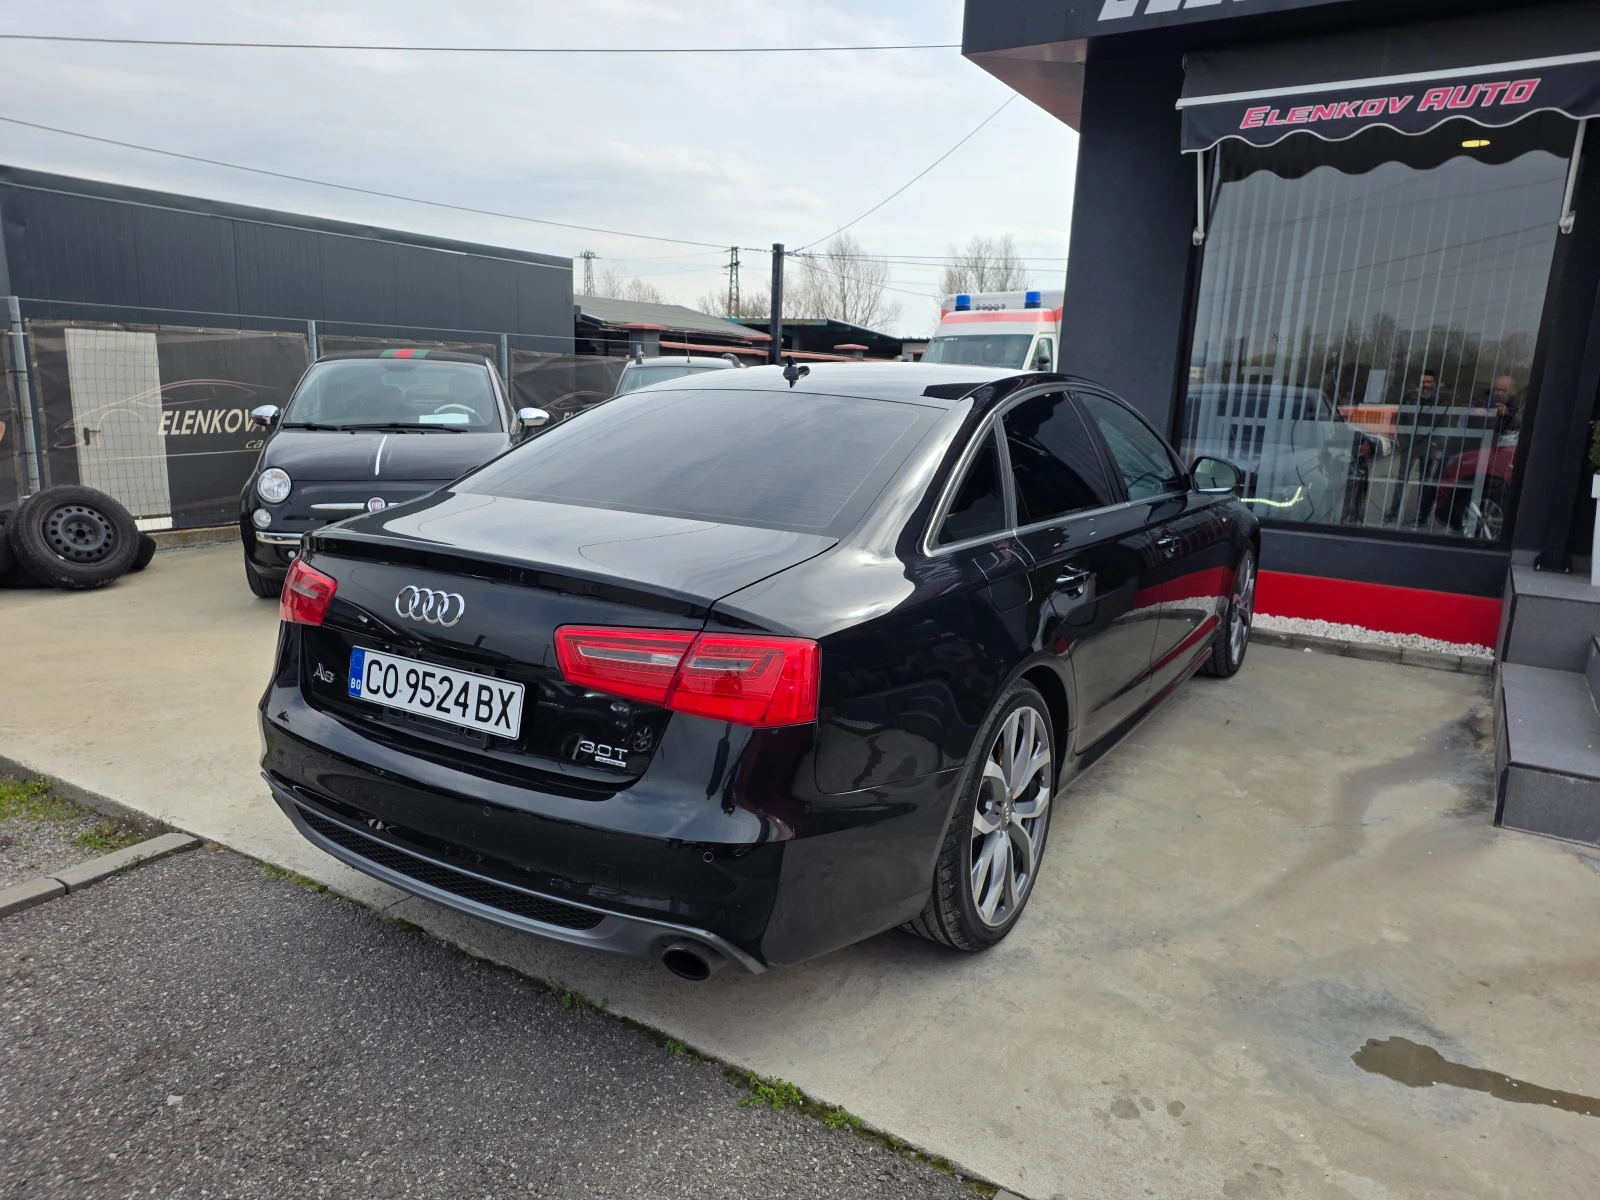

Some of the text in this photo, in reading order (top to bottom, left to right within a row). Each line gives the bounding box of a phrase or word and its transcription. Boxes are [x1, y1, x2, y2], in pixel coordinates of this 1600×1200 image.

[1239, 78, 1541, 129] ELENKOV AUTO
[350, 677, 361, 690] BG
